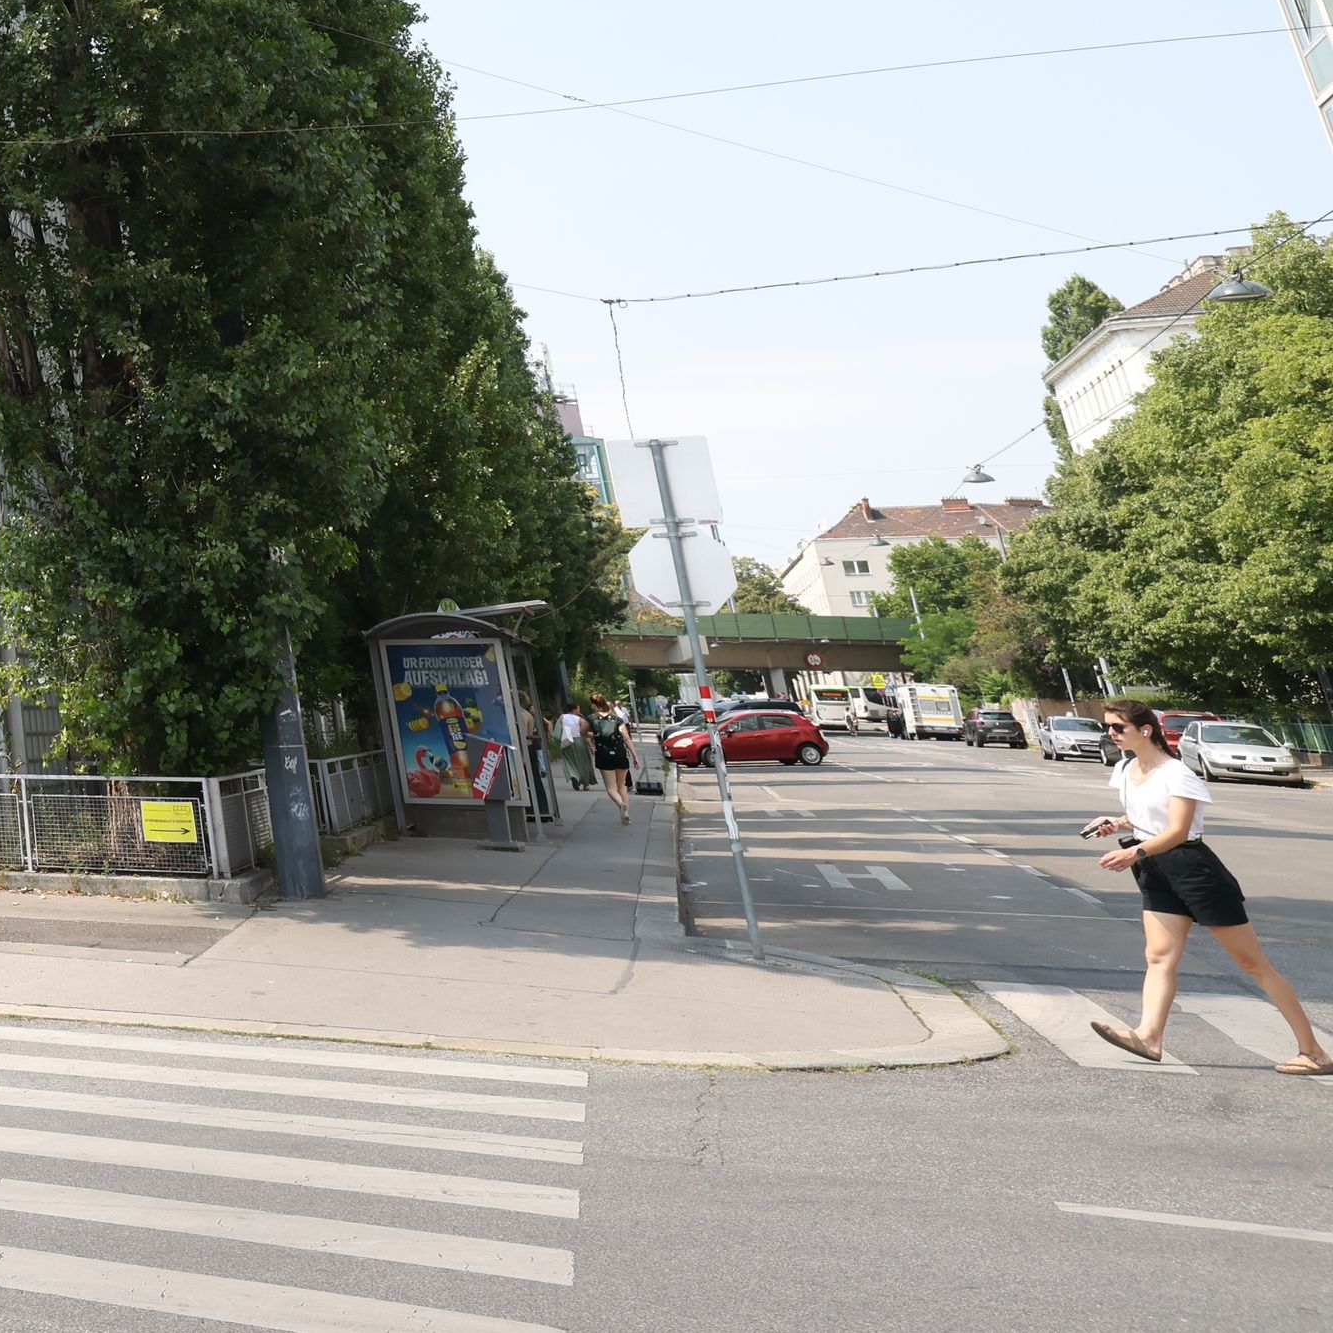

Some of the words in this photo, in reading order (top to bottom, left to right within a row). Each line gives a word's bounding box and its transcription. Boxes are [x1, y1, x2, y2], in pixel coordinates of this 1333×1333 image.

[444, 601, 453, 611] H
[403, 657, 417, 669] UR
[419, 656, 485, 669] FRUCHTIGER
[403, 670, 490, 686] AUFSCHLAG!
[473, 750, 498, 793] Heute
[814, 863, 913, 891] H
